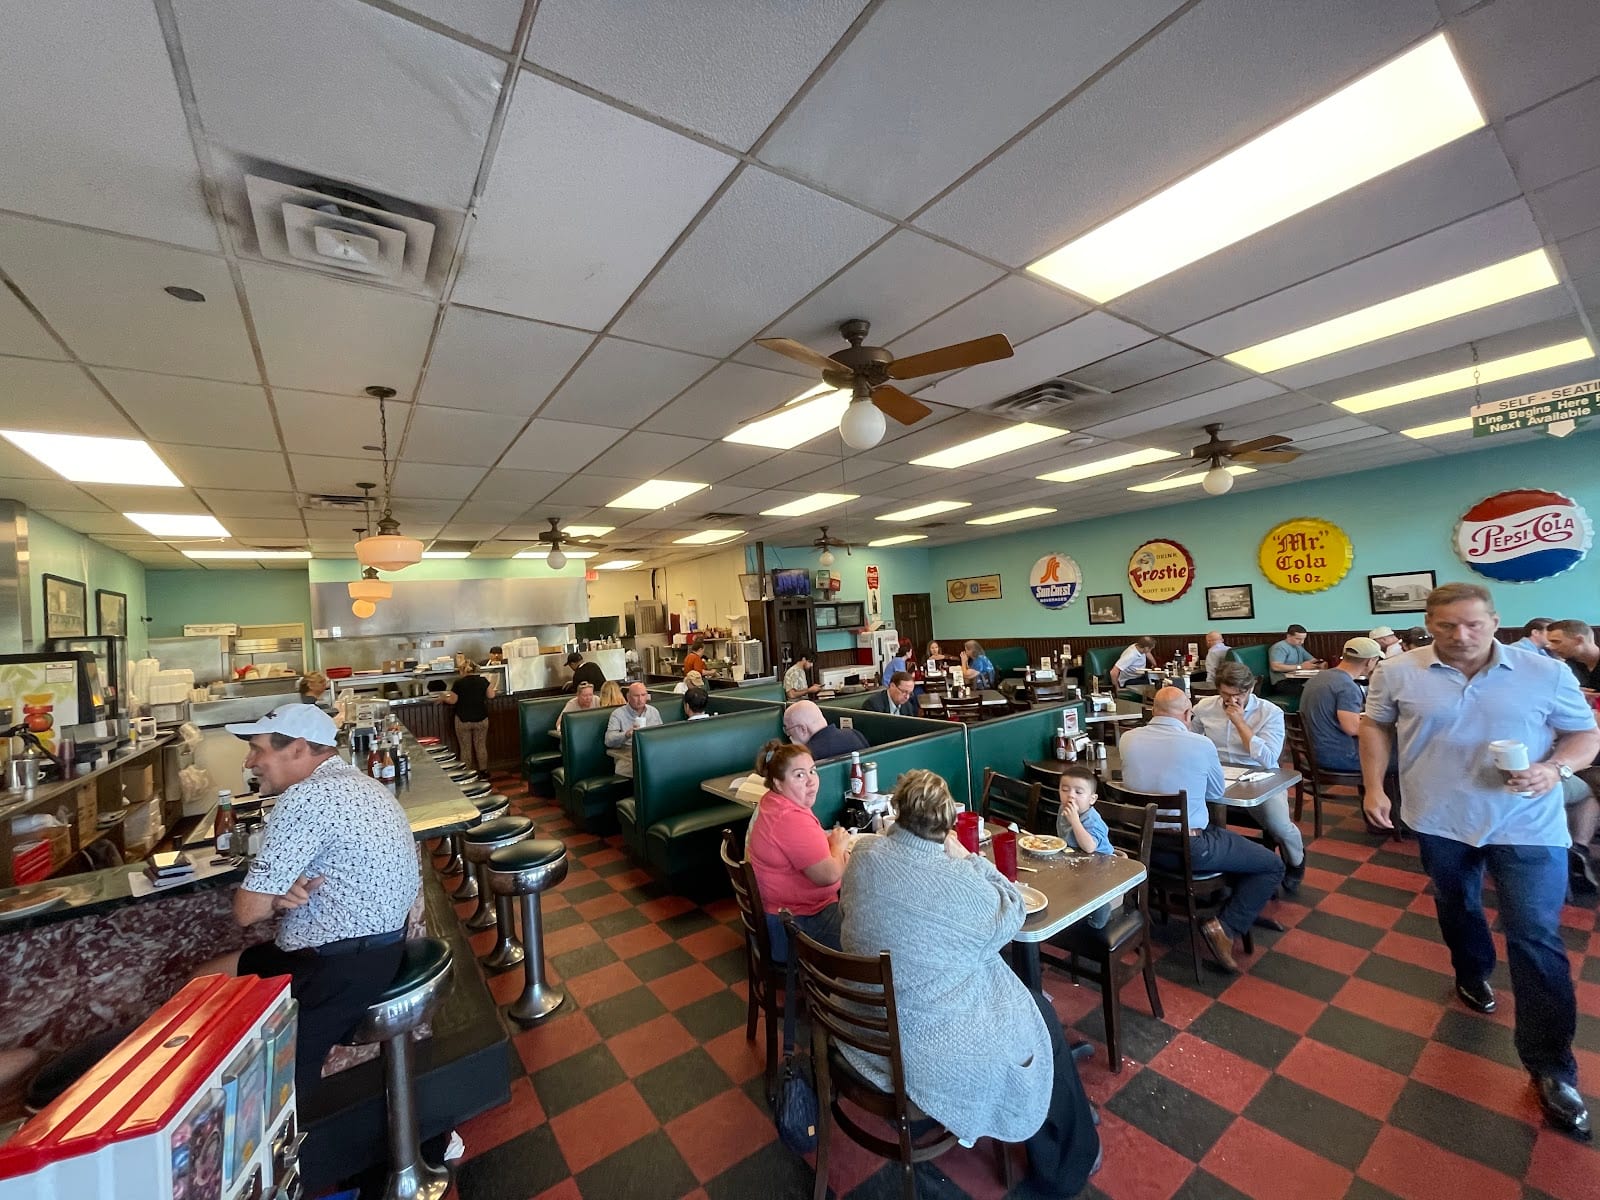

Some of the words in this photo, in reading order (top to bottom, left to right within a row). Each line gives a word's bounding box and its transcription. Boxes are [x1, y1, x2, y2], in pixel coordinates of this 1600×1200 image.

[1478, 415, 1503, 426] Line
[1508, 404, 1552, 418] Begins
[1557, 397, 1590, 410] Here
[1499, 395, 1536, 410] SELF
[1489, 420, 1521, 433] Next
[1527, 406, 1592, 426] Available
[1276, 553, 1327, 571] Cola
[1129, 562, 1186, 588] Frostie
[1287, 574, 1300, 584] 16
